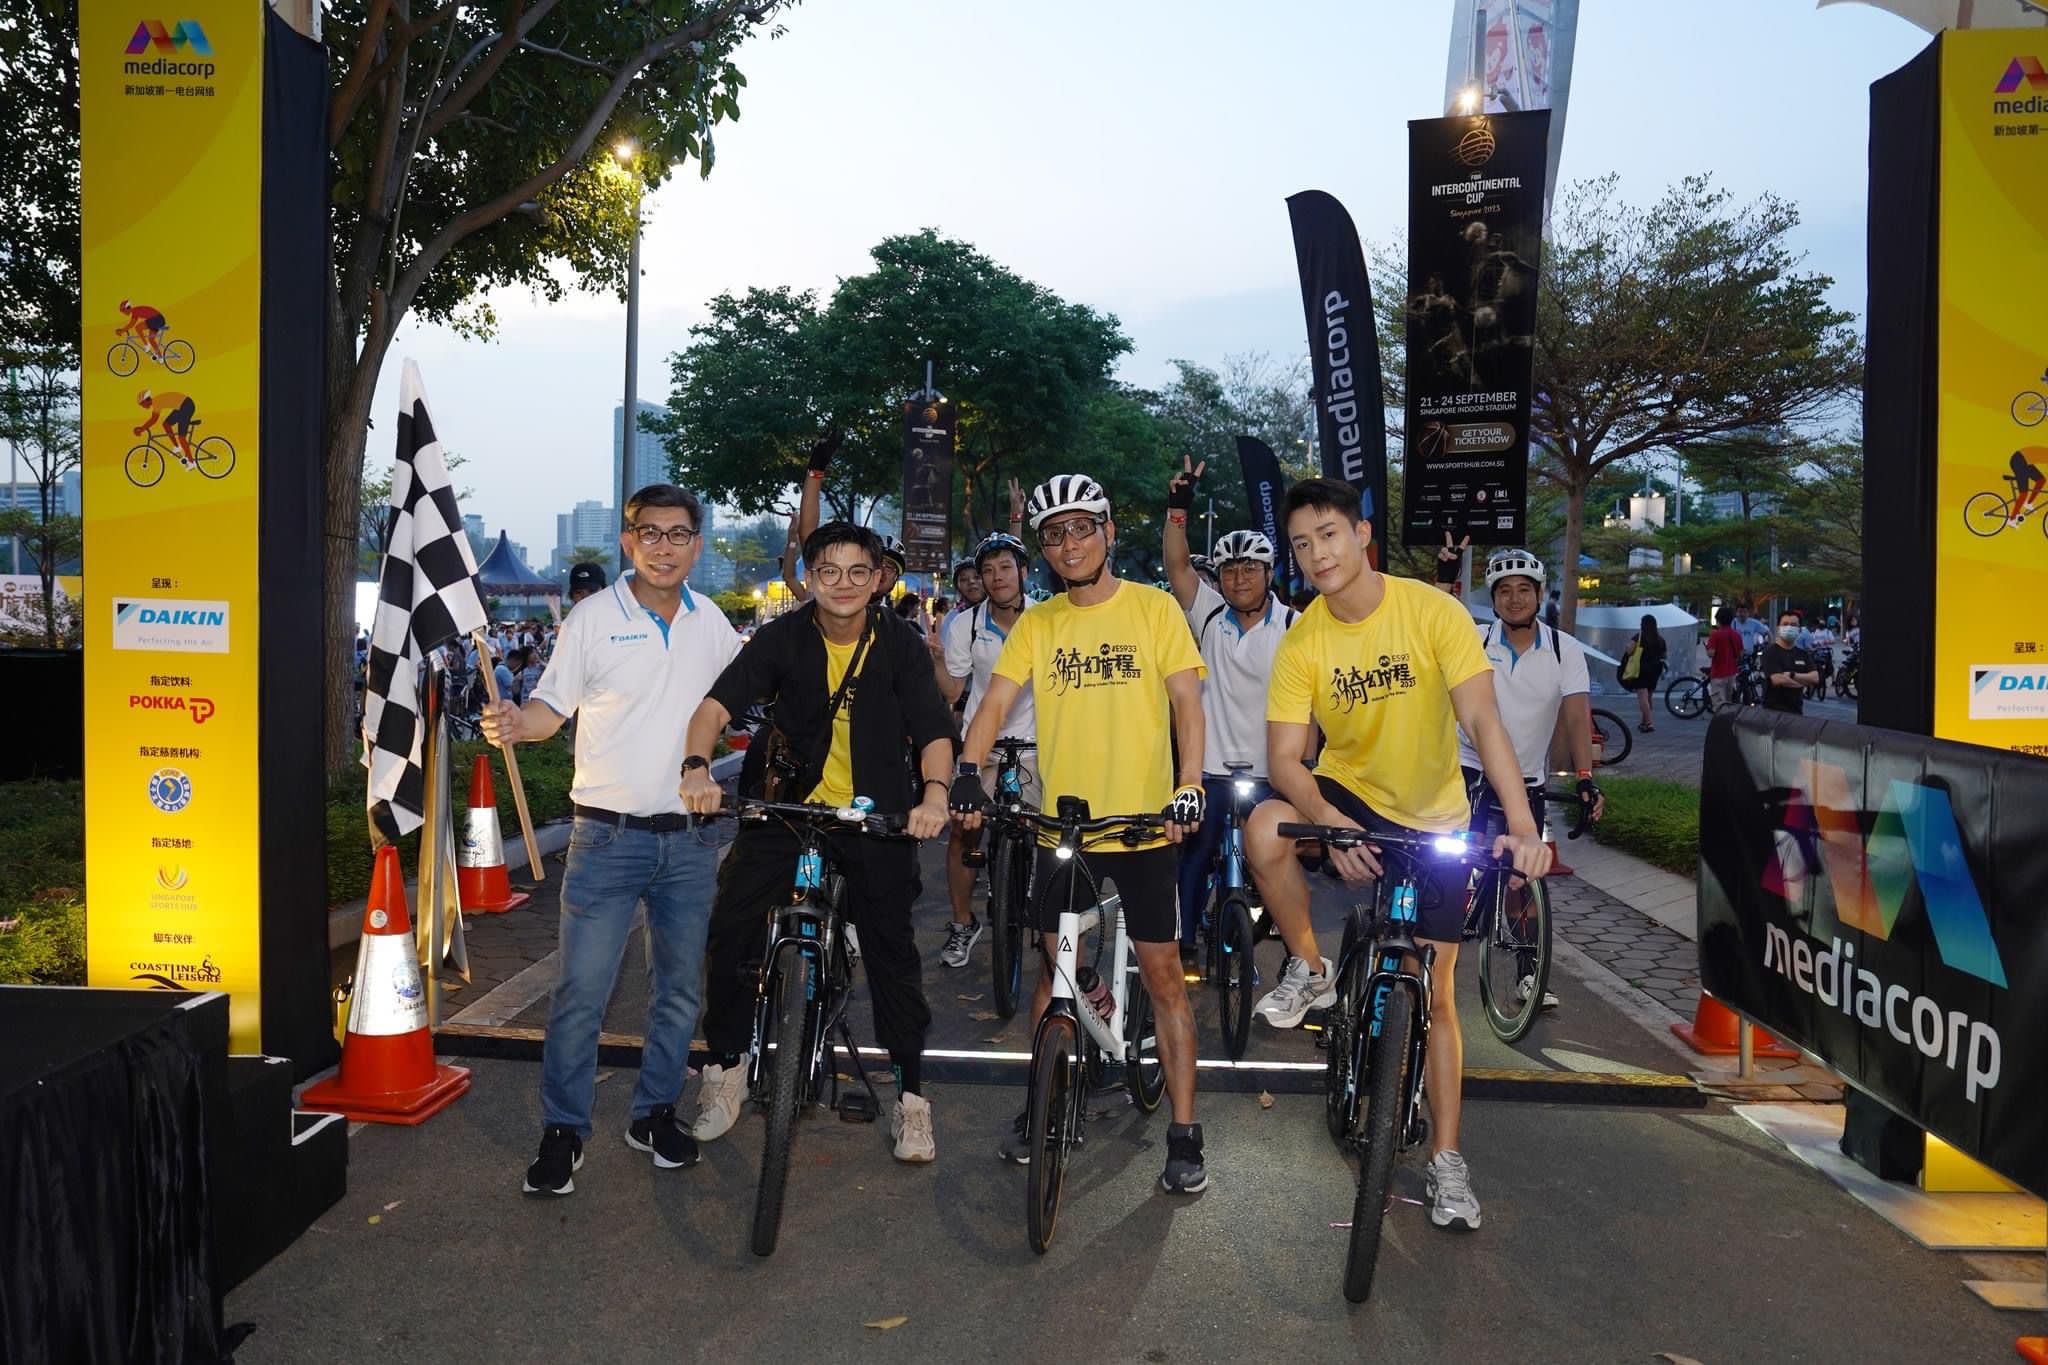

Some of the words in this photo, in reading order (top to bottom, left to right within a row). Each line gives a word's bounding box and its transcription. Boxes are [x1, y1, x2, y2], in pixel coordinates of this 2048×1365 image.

[124, 58, 215, 80] mediacorp
[125, 85, 215, 96] 新加坡第一电台网络
[1432, 178, 1521, 196] INTERCONTINENTAL
[1466, 192, 1485, 205] CUP
[1325, 290, 1364, 481] mediacorp
[1420, 397, 1432, 407] 21
[1441, 395, 1454, 406] 24
[1455, 391, 1517, 405] SEPTEMBER
[1420, 405, 1456, 416] SINGAPORE
[1457, 403, 1485, 414] INDOOR
[1485, 403, 1517, 412] STADIUM
[1462, 429, 1477, 437] GET
[1479, 427, 1503, 437] YOUR
[1454, 437, 1488, 447] TICKETS
[1488, 435, 1510, 445] NOW
[1427, 461, 1504, 470] WWW.SPORTSHUB.COM.SG
[139, 609, 224, 625] DAIKIN
[1999, 674, 2048, 691] DAI
[129, 695, 186, 710] POKKA
[130, 962, 198, 977] COASTLINE
[171, 968, 222, 983] LEISURE
[1763, 921, 2002, 1104] mediacorp
